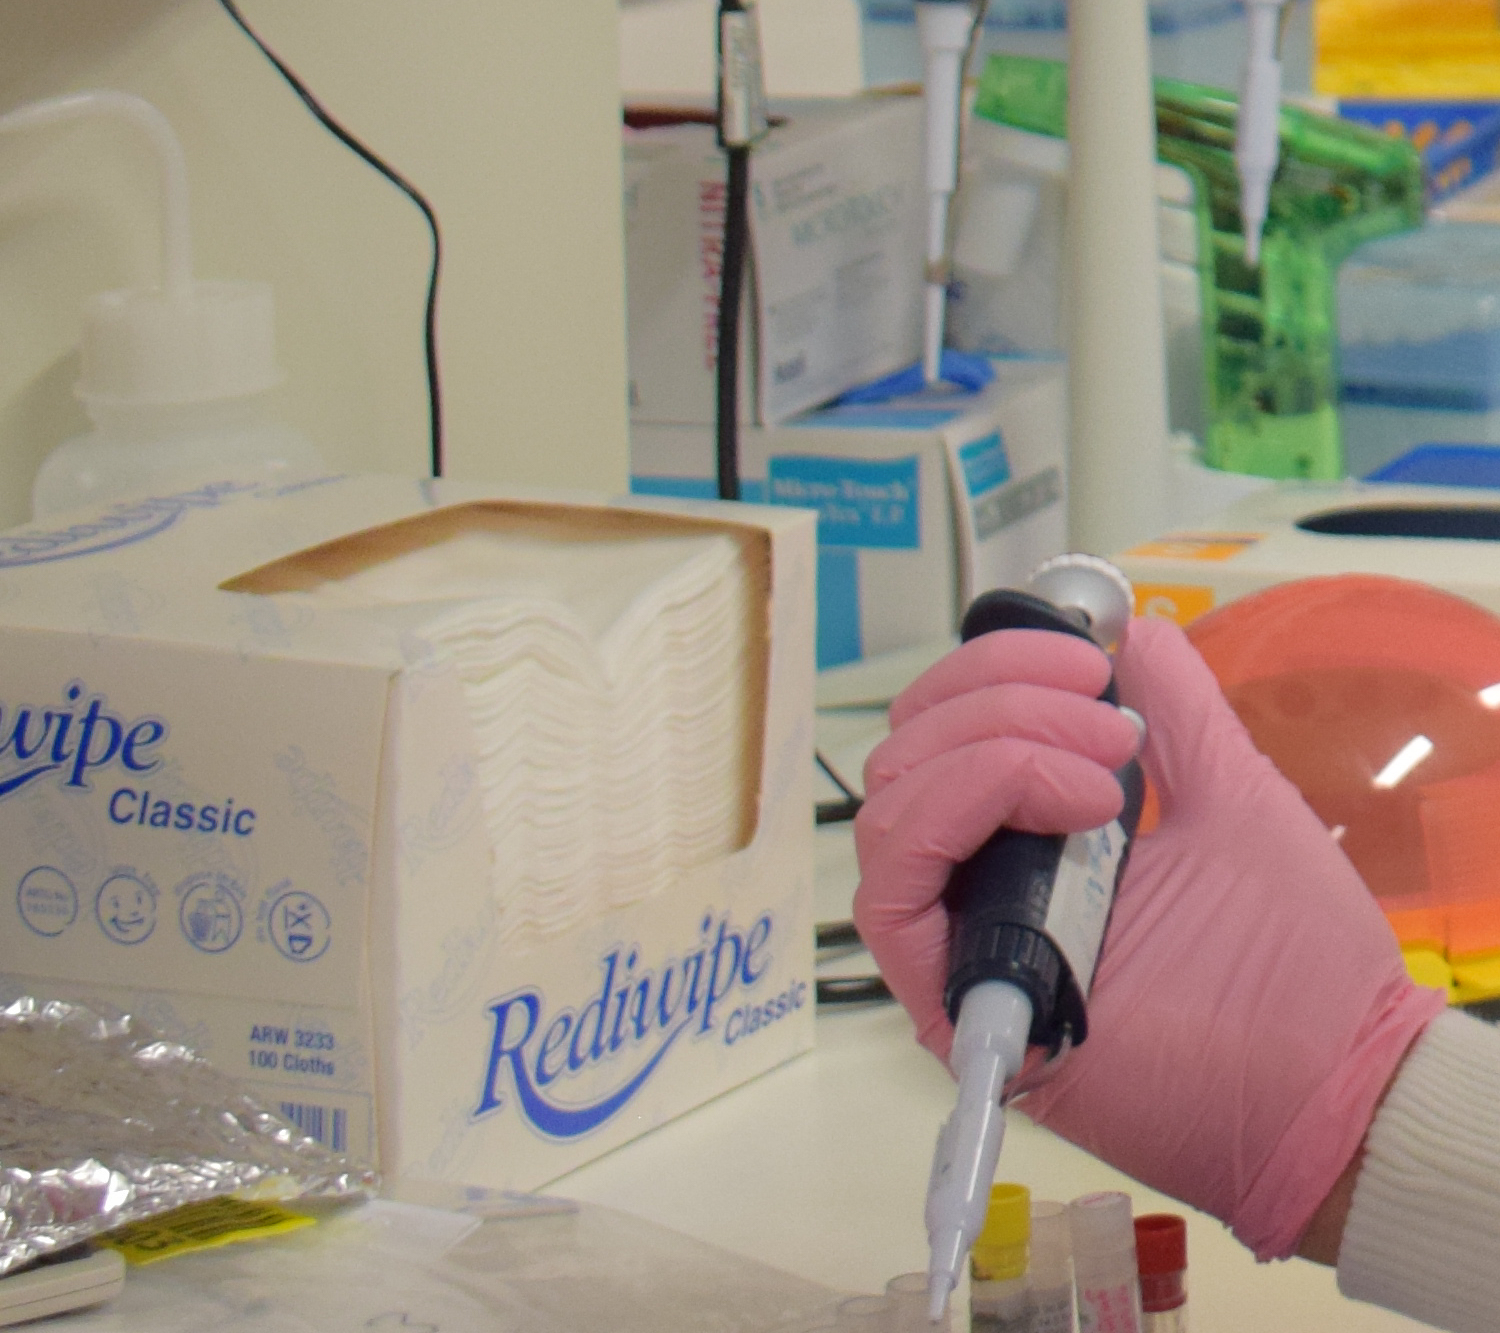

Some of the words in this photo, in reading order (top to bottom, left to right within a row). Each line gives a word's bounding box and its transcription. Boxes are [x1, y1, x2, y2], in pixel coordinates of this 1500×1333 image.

[108, 787, 256, 835] Classic
[473, 913, 771, 1139] Rediwipe
[723, 981, 807, 1046] Classic
[249, 1025, 289, 1046] ARW
[294, 1028, 335, 1052] 3233
[249, 1049, 279, 1070] 100
[283, 1052, 335, 1077] Cloths
